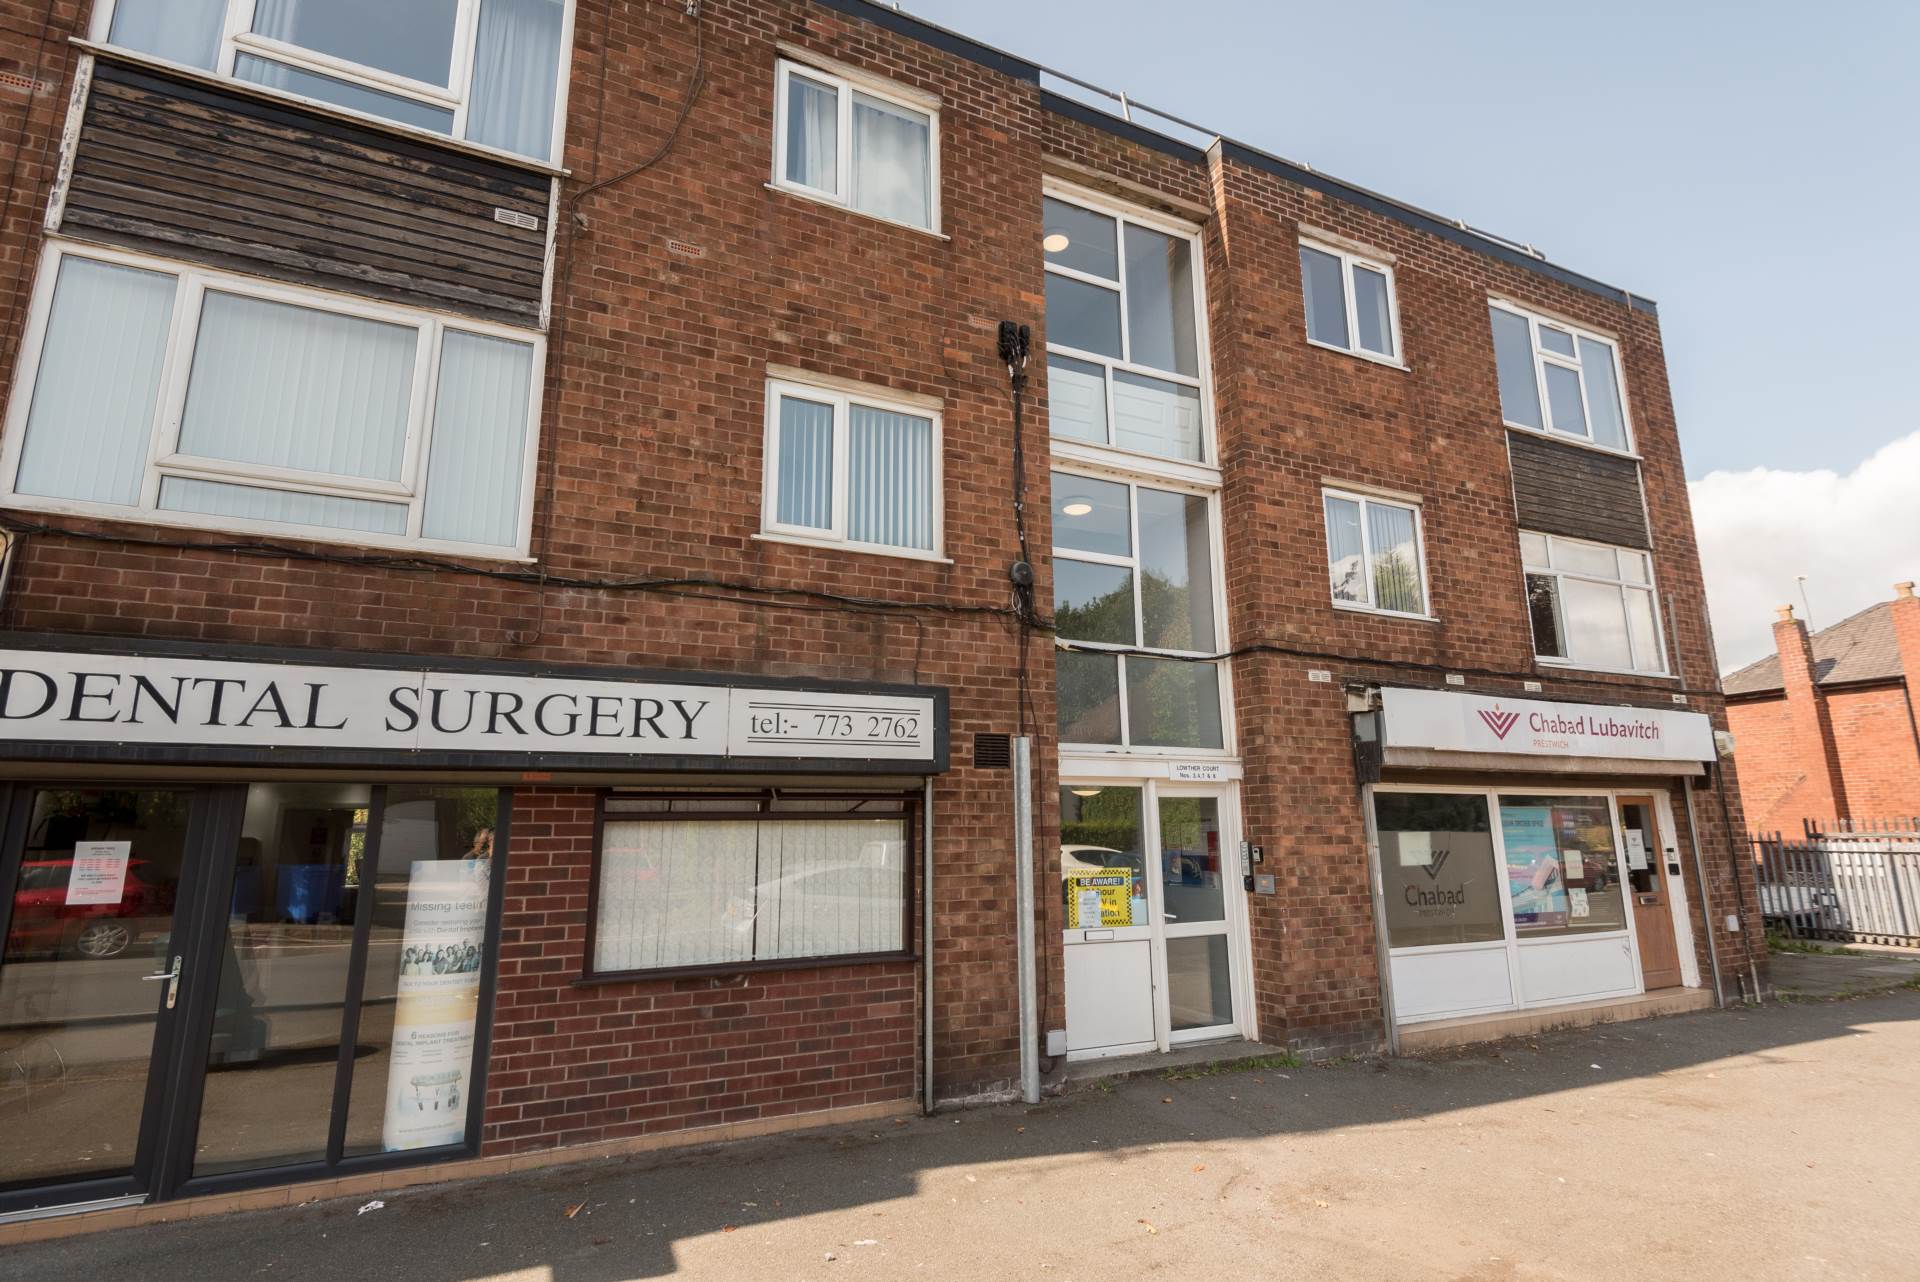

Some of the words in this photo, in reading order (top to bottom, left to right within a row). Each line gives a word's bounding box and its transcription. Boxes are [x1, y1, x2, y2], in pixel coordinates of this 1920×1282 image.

[0, 668, 348, 730] DENTAL
[385, 685, 711, 740] SURGERY
[751, 711, 798, 735] tel:-
[813, 713, 853, 737] 773
[868, 715, 919, 740] 2762
[1529, 712, 1585, 735] Chabad
[1589, 716, 1659, 740] Lubavitch
[1533, 739, 1569, 749] PRESTWICH
[1092, 877, 1121, 886] AWARE!
[1405, 883, 1464, 906] Chabad
[410, 901, 451, 913] Missing
